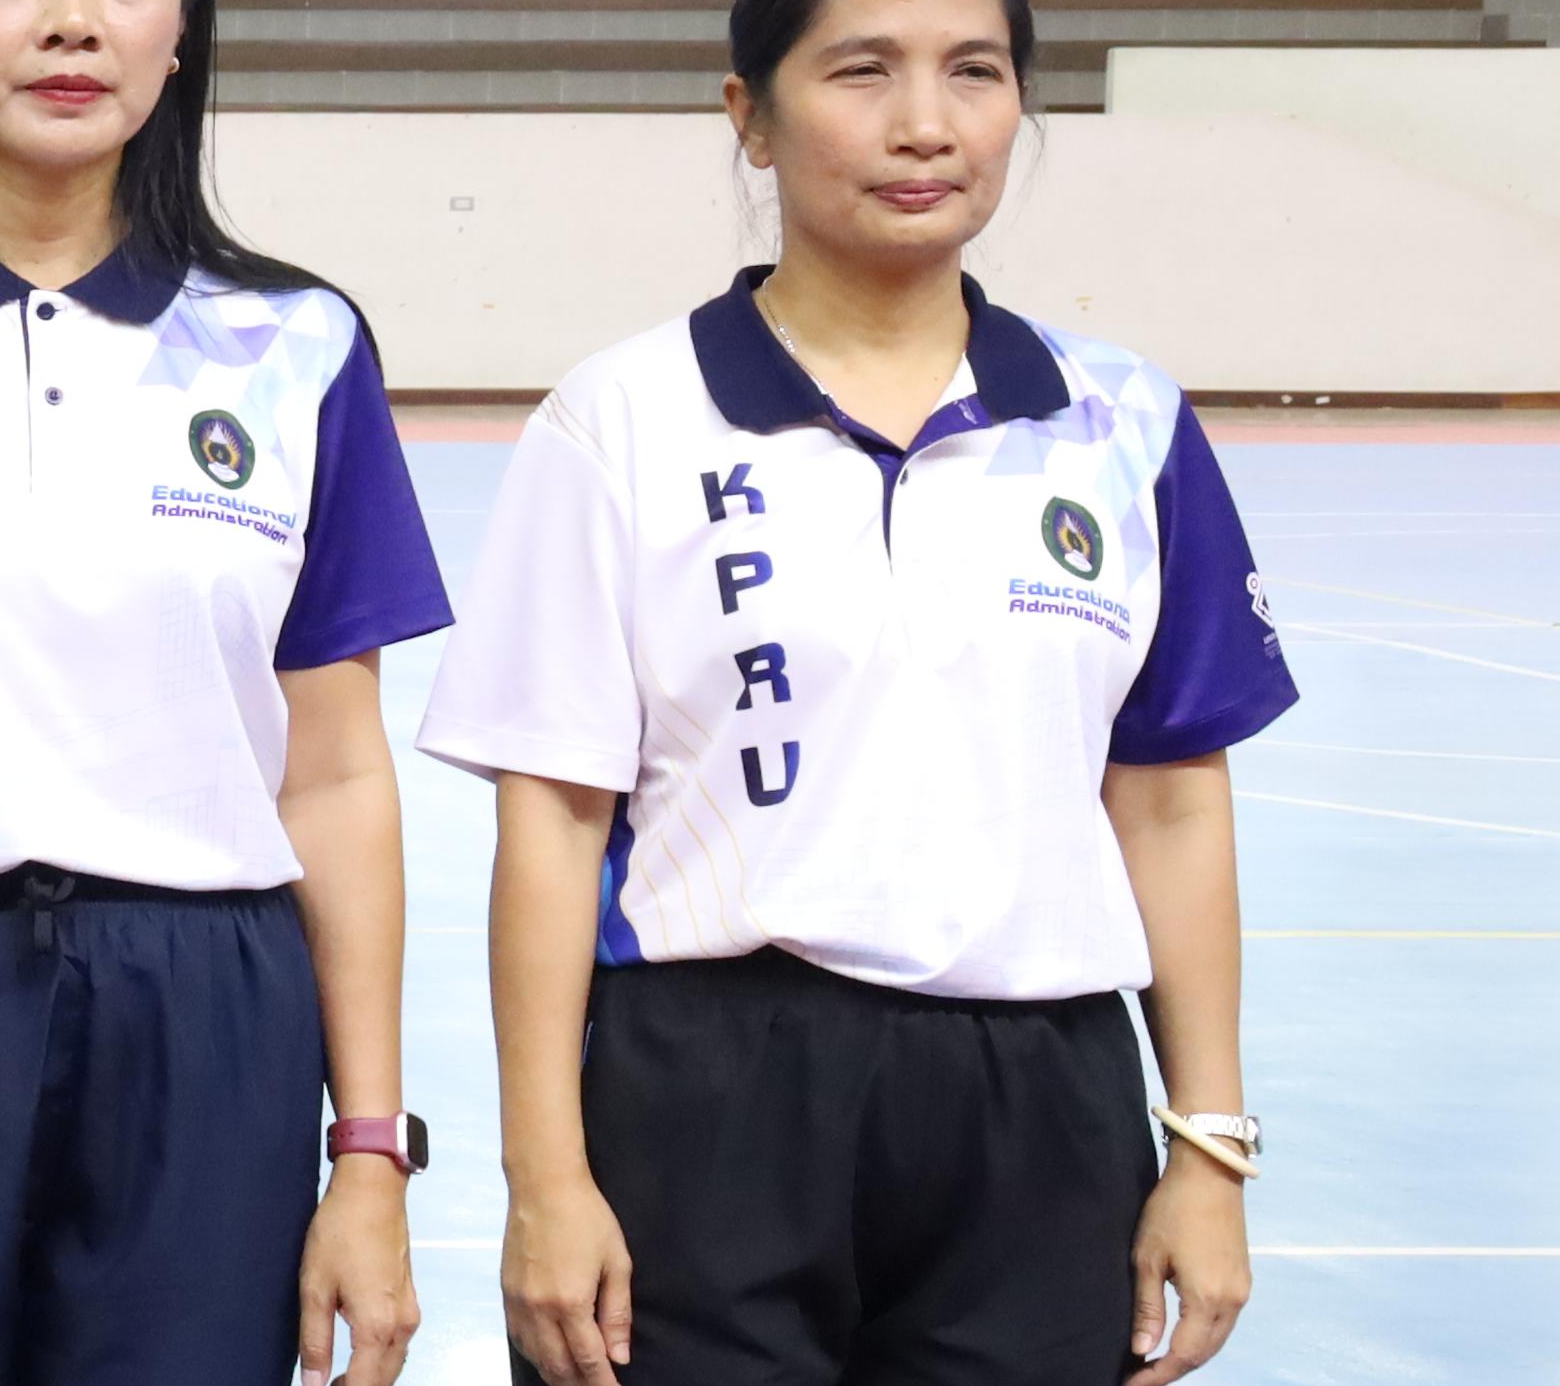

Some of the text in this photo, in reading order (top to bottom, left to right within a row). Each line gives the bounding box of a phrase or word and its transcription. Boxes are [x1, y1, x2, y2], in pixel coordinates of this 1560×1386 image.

[152, 485, 297, 529] Educational
[152, 504, 288, 545] Administration
[700, 463, 801, 807] KPRU
[1010, 599, 1131, 645] Administration
